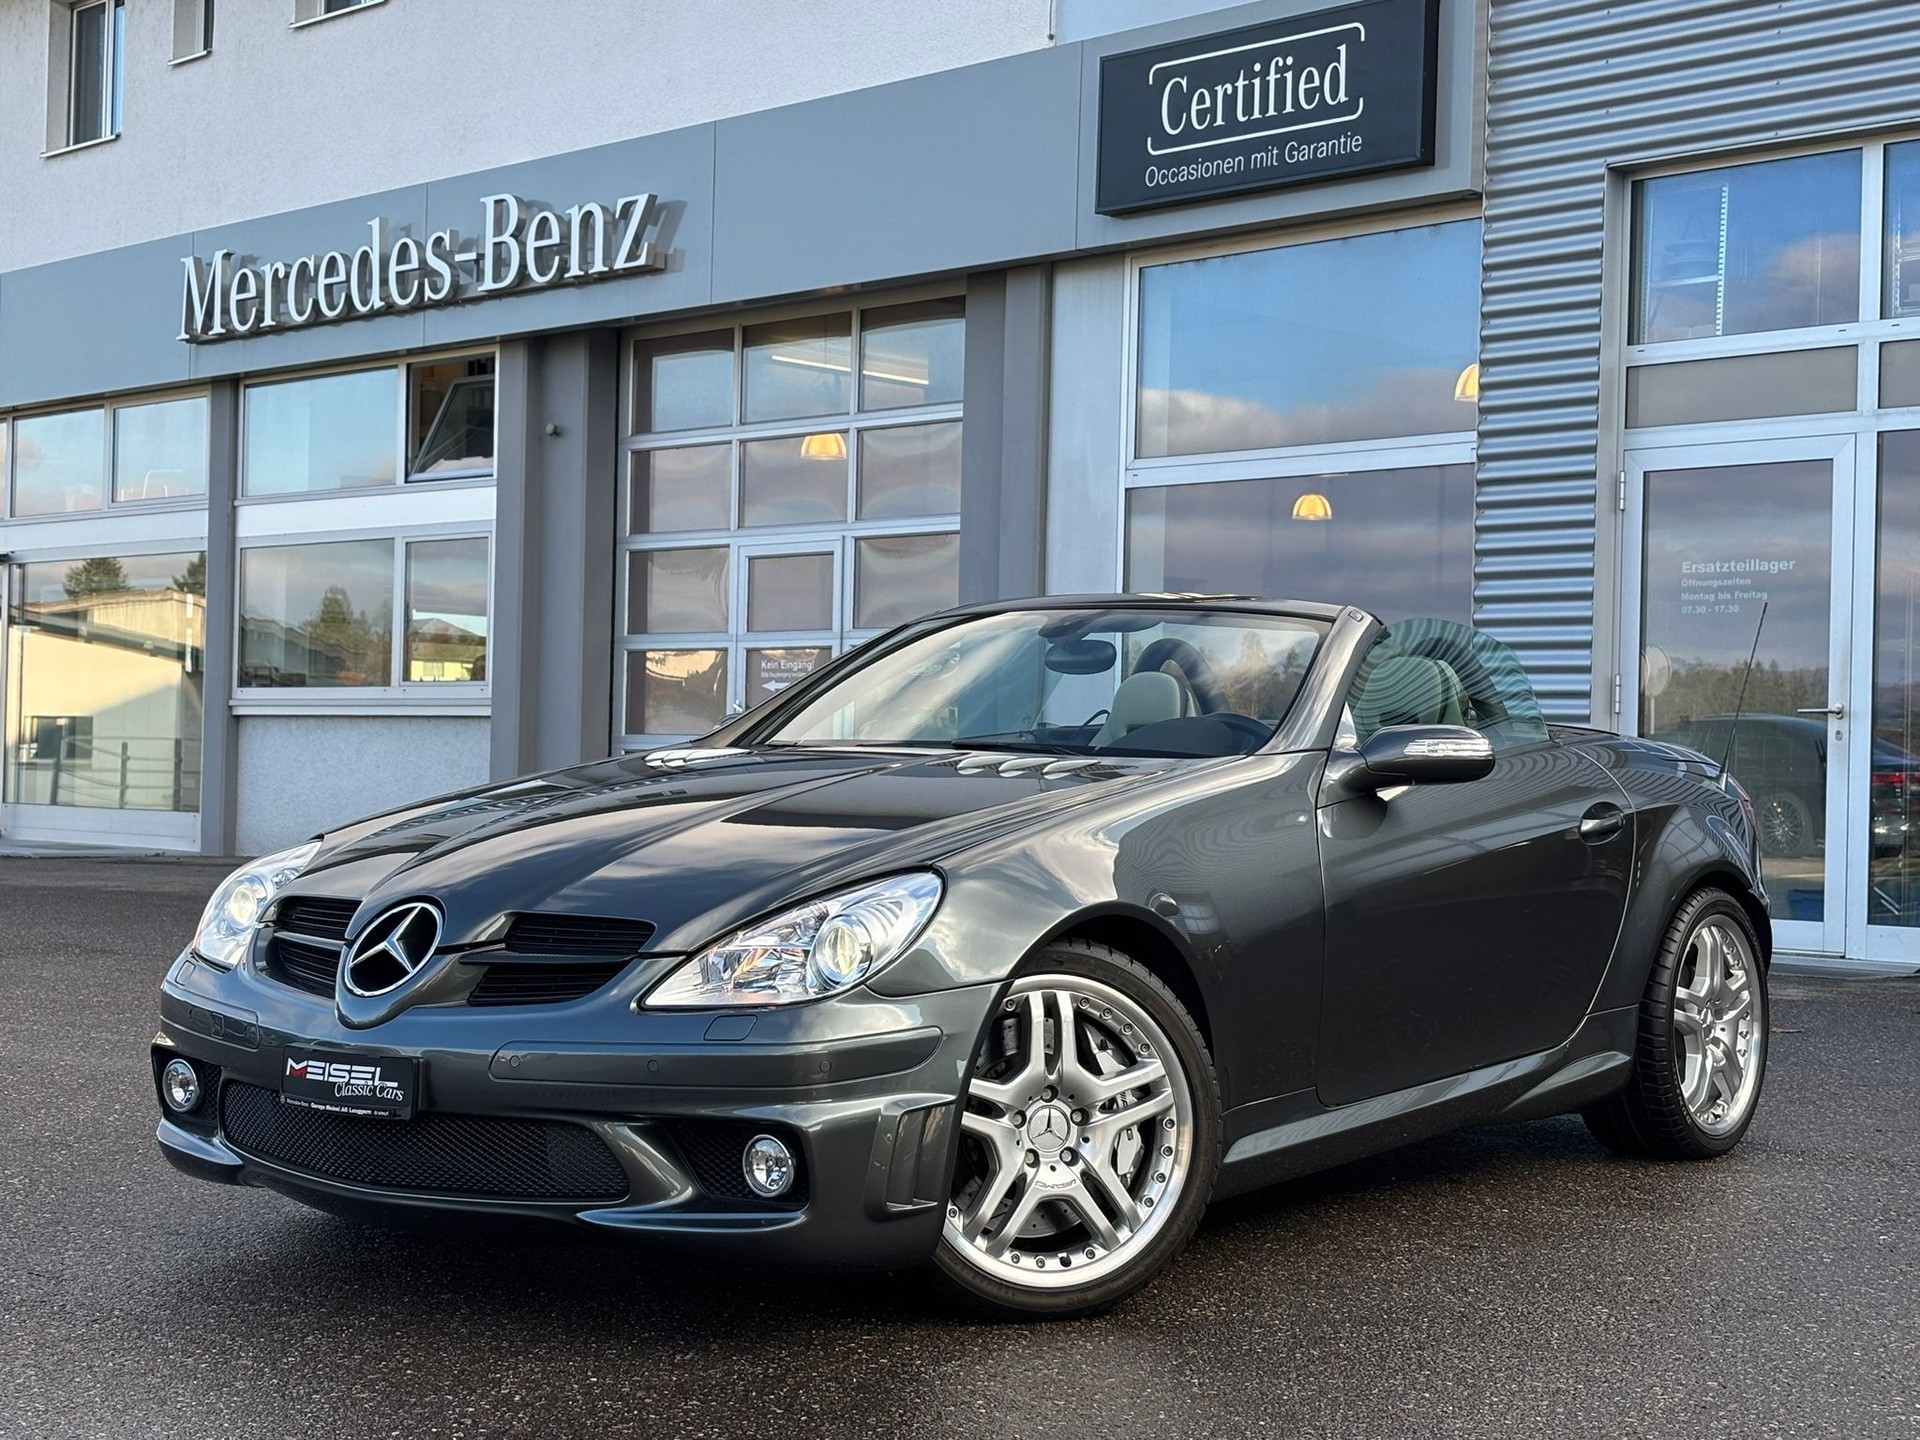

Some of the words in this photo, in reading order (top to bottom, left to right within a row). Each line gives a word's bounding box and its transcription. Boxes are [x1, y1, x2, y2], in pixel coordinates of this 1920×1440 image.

[1161, 43, 1349, 136] Certified
[1145, 155, 1245, 187] Occasionen
[1250, 146, 1279, 171] mit
[1284, 131, 1363, 163] Garantie
[176, 192, 656, 342] Mercedes-Benz
[1681, 559, 1796, 574] Ersatzteillager
[1681, 592, 1716, 601] Montag
[1718, 591, 1731, 600] bis
[1734, 591, 1768, 601] Freitag
[761, 660, 779, 670] Kein
[286, 1057, 398, 1088] MEISEL
[334, 1082, 374, 1098] Classic
[376, 1083, 404, 1102] Cars
